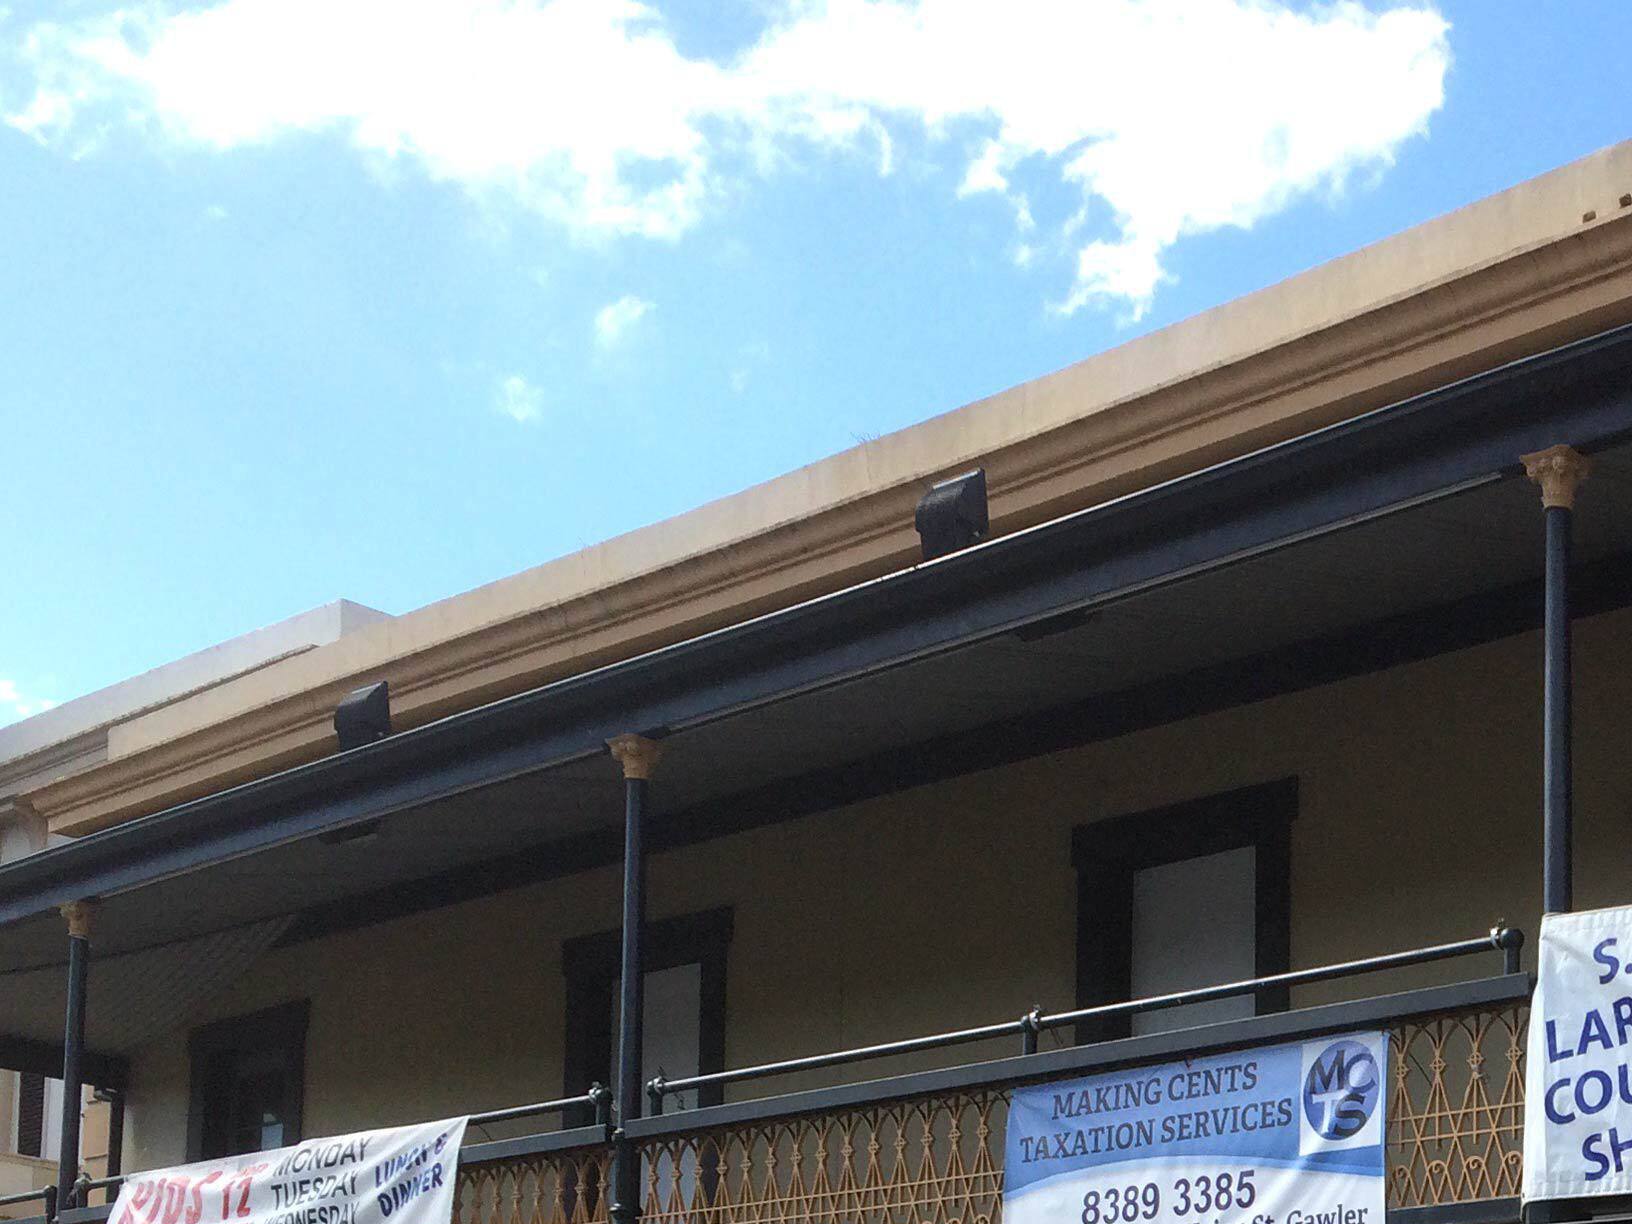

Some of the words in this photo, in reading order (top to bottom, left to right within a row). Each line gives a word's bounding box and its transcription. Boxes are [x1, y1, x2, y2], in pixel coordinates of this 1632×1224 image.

[1051, 1077, 1163, 1120] MAKING
[1167, 1062, 1259, 1100] CENTS
[272, 1137, 369, 1176] MONDAY
[1019, 1123, 1155, 1164] TAXATION
[1160, 1098, 1293, 1144] SERVICES
[270, 1170, 360, 1211] TUESDAY
[377, 1162, 443, 1218] DINNER
[1173, 1170, 1258, 1217] 3385
